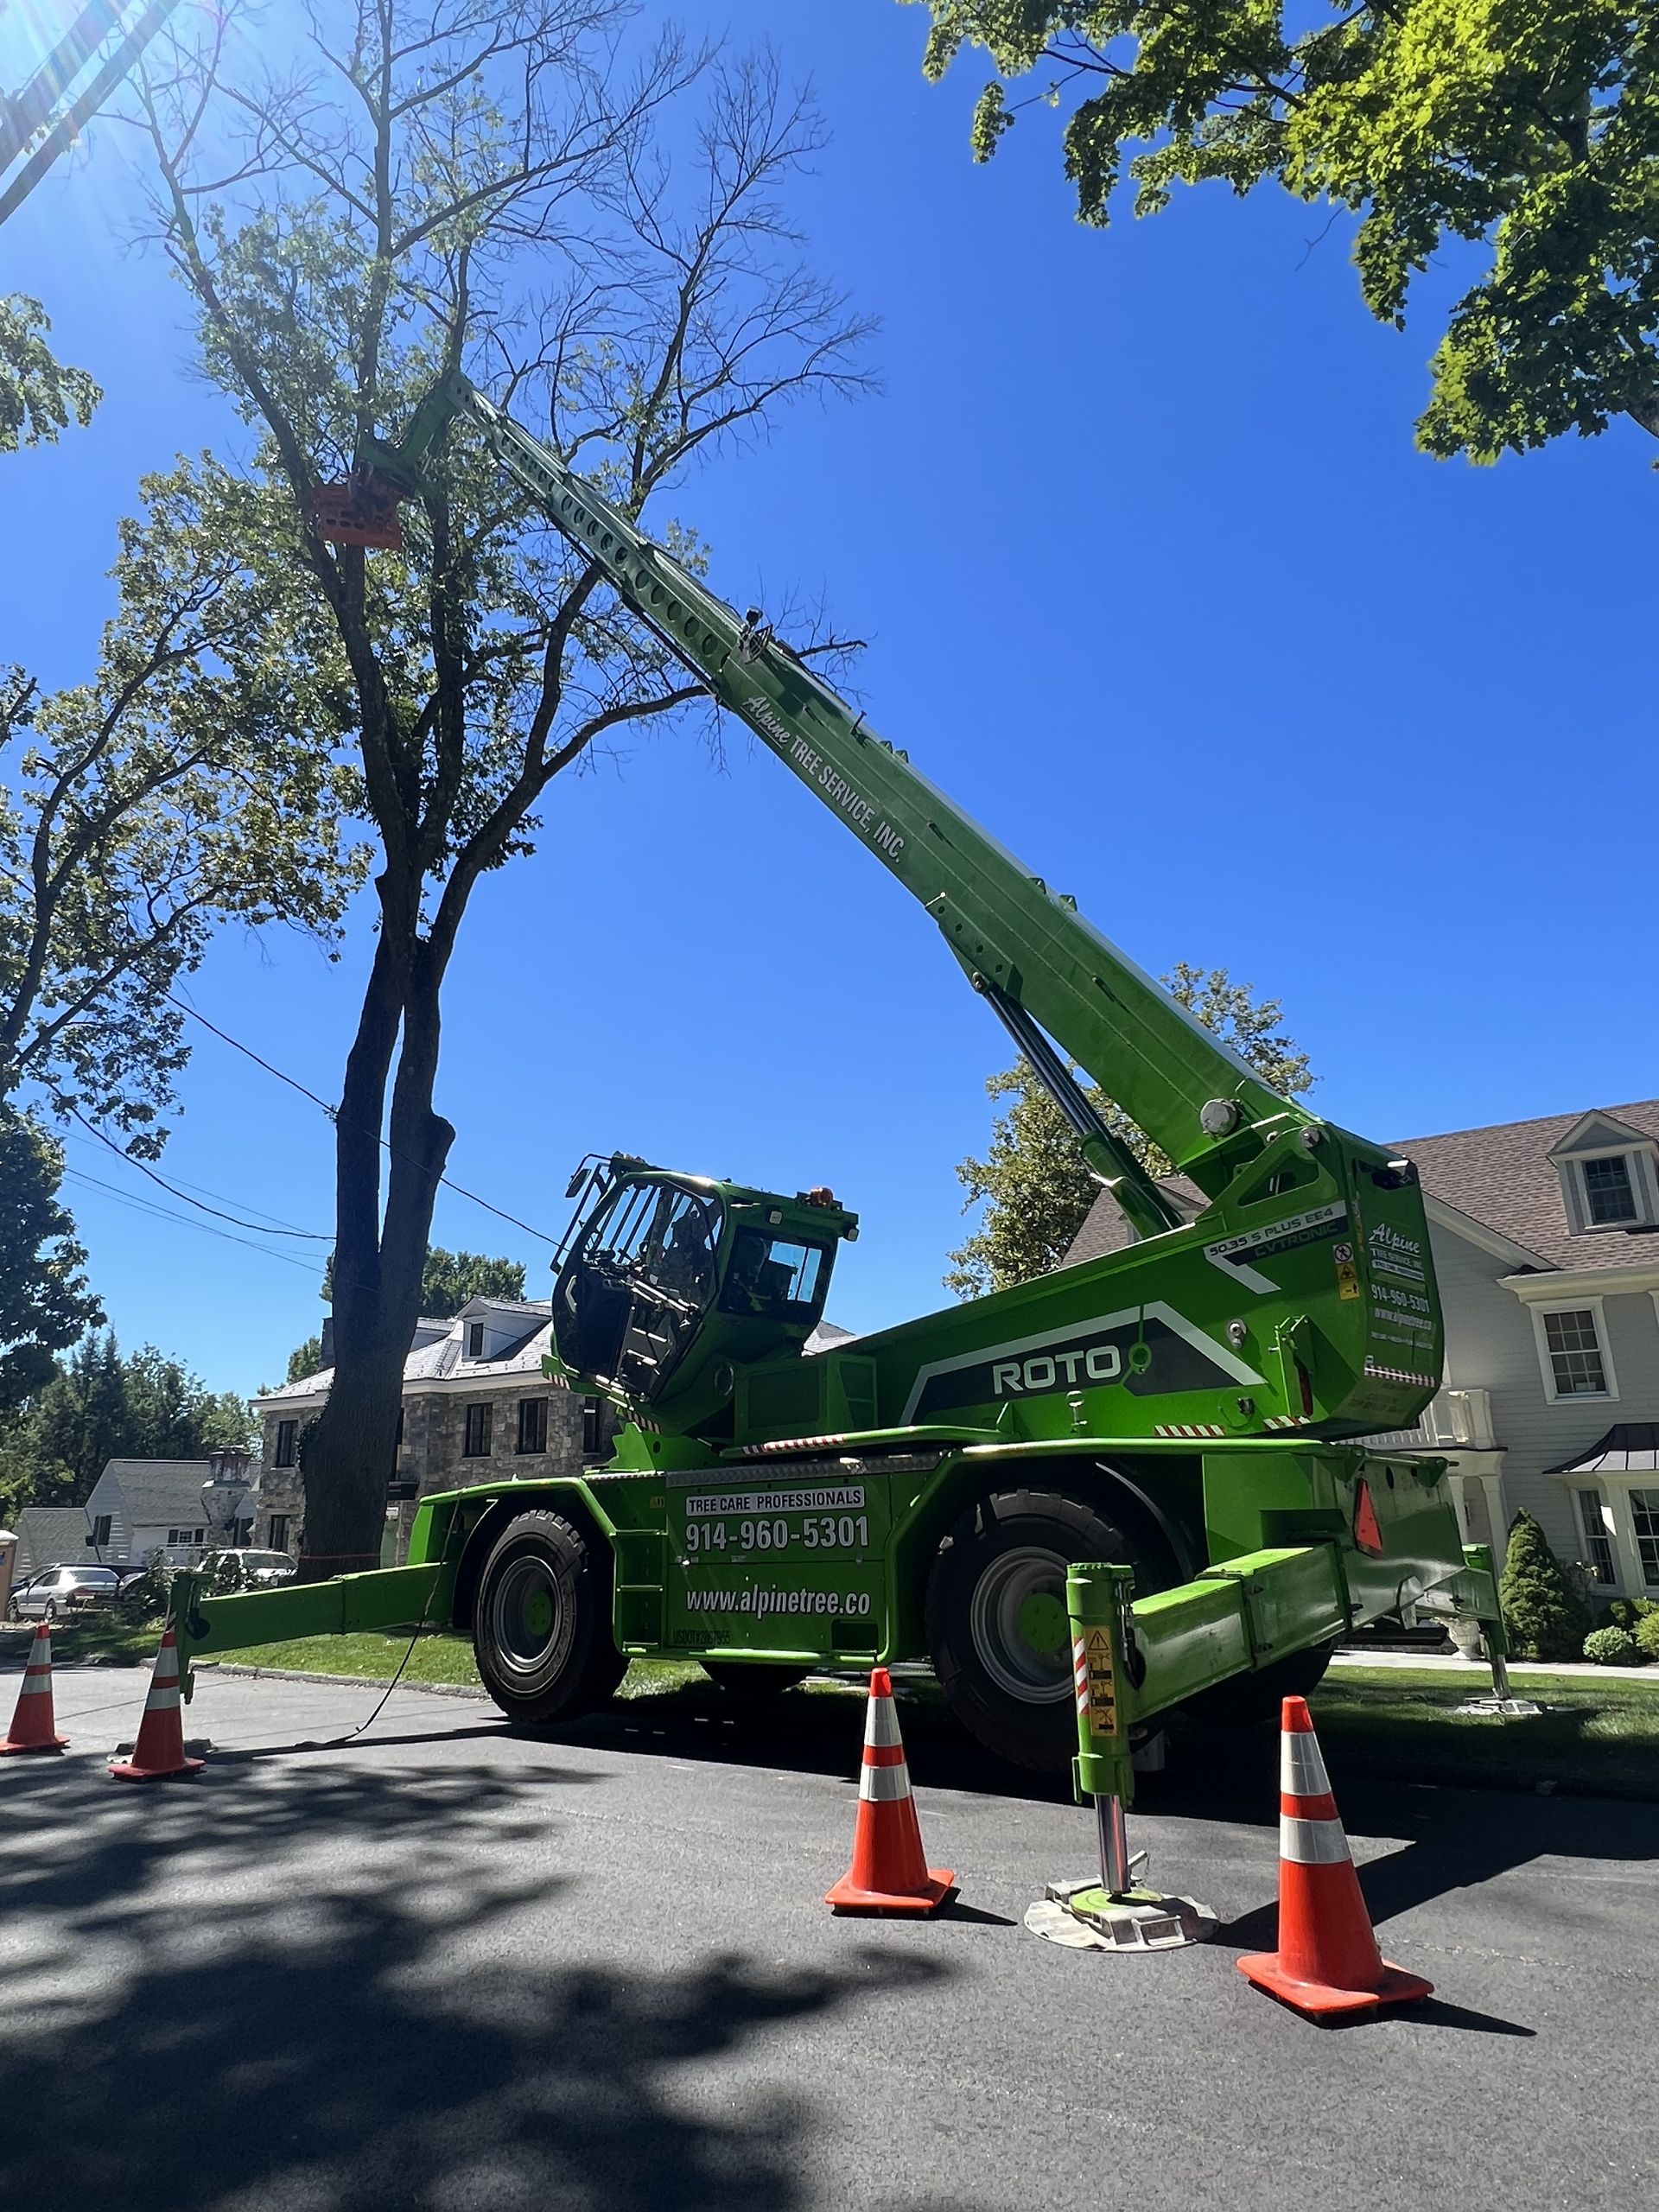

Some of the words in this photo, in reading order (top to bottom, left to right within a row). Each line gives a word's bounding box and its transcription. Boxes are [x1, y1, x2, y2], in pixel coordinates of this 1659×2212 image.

[741, 696, 790, 745] Alpine
[789, 735, 823, 776] TREE
[818, 765, 876, 834] SERVICE,
[873, 821, 905, 863] INC.
[1210, 1236, 1248, 1256] 50.35
[1252, 1232, 1262, 1242] S
[1264, 1218, 1301, 1237] PLUS
[1369, 1223, 1421, 1254] Alpine
[1371, 1284, 1430, 1313] 914-960-5301
[993, 1344, 1122, 1395] ROTO
[689, 1498, 716, 1512] TREE
[720, 1497, 750, 1511] CARE
[757, 1490, 861, 1509] PROFESSIONALS
[685, 1516, 868, 1551] 914-960-5301
[686, 1584, 870, 1619] www.alpinetree.co
